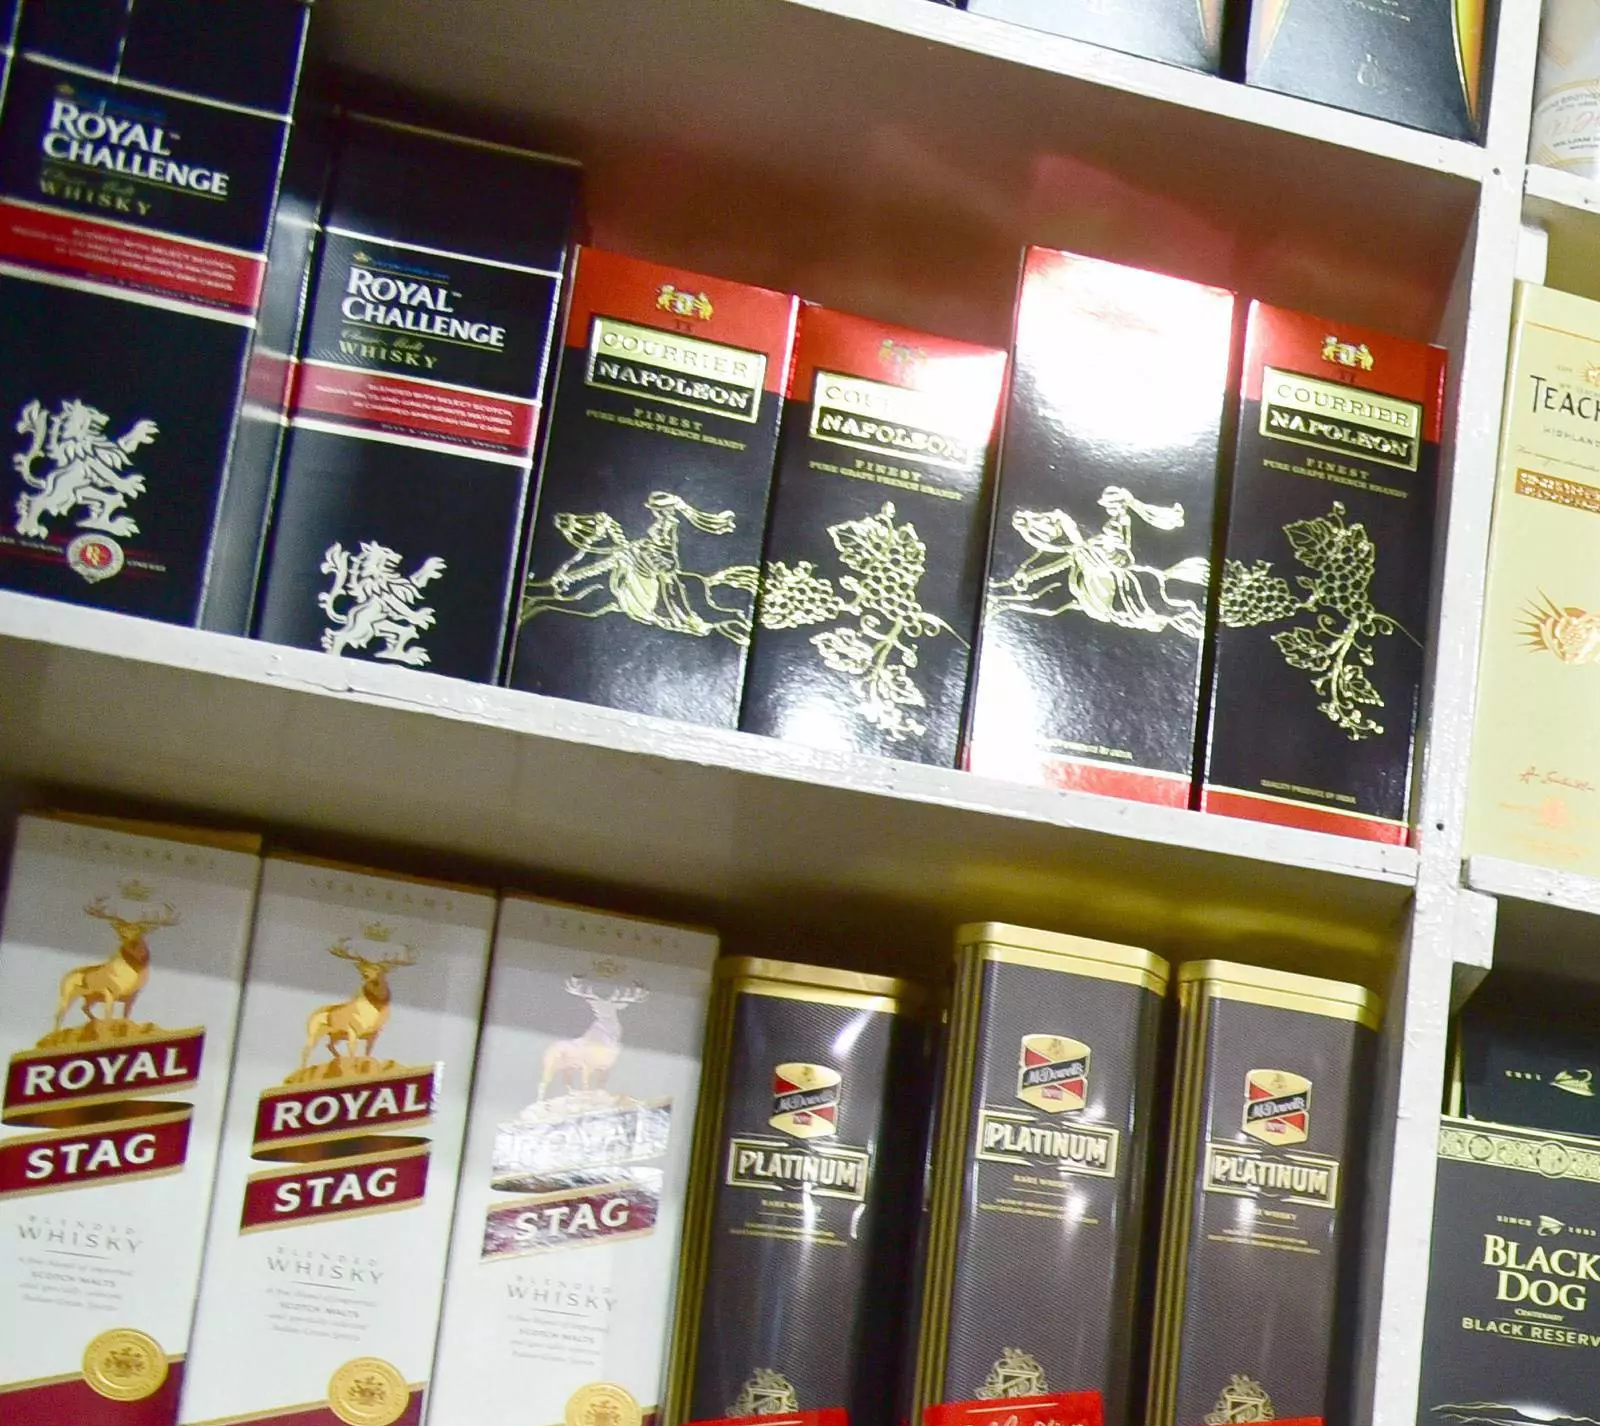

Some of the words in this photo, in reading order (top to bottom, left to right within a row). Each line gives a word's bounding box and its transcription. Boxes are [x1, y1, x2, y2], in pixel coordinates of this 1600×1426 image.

[51, 99, 171, 156] ROYAL
[43, 132, 229, 195] CHALLENGE
[40, 179, 151, 215] WHISKY
[347, 266, 453, 312] ROYAL
[342, 297, 506, 347] CHALLENGE
[339, 340, 438, 370] WHISKY
[603, 332, 749, 378] COURRIER
[598, 361, 749, 409] NAPOLEON
[1277, 384, 1410, 427] COURRIER
[634, 407, 704, 433] FINEST
[821, 413, 968, 464] NAPOLEON
[1270, 410, 1408, 457] NAPOLEON
[855, 459, 922, 482] FINEST
[1306, 457, 1370, 480] FINEST
[23, 1047, 189, 1096] ROYAL
[272, 1083, 427, 1131] ROYAL
[25, 1132, 157, 1180] STAG
[984, 1122, 1107, 1166] PLATINUM
[274, 1167, 398, 1213] STAG
[739, 1148, 862, 1191] PLATINUM
[1214, 1155, 1329, 1196] PLATINUM
[18, 1225, 144, 1253] WHISKY
[515, 1198, 629, 1241] STAG
[1496, 1214, 1532, 1228] SINCE
[266, 1257, 385, 1285] WHISKY
[1496, 1270, 1587, 1313] DOG
[506, 1284, 618, 1311] WHISKY
[1461, 1317, 1523, 1339] BLACK
